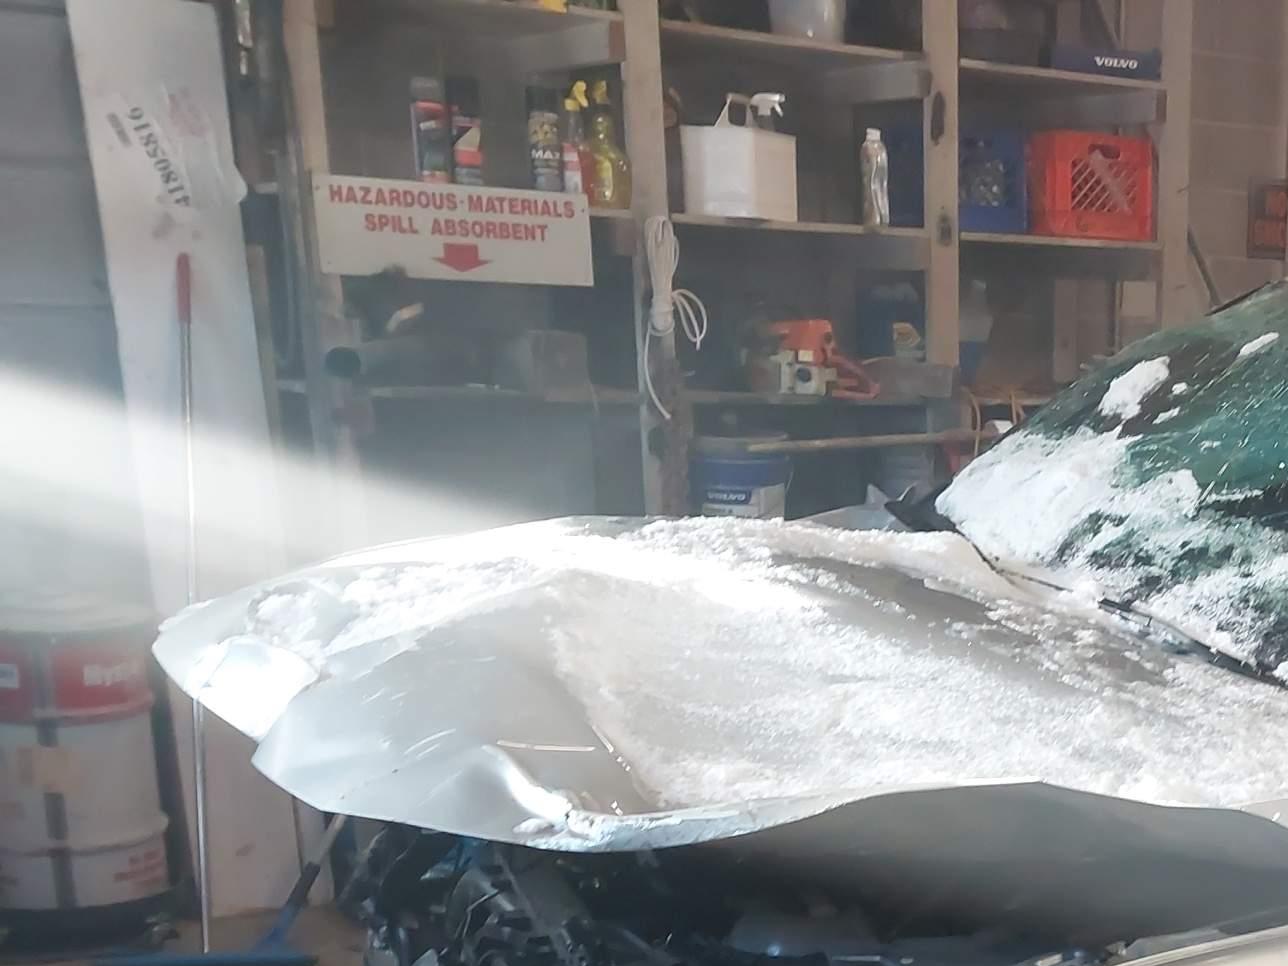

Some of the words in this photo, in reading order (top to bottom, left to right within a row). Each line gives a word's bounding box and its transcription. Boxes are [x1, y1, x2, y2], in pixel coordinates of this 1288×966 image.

[1094, 55, 1139, 70] VOLVO
[328, 183, 459, 212] HAZARDOUS
[467, 194, 576, 219] MATERIALS
[364, 212, 419, 235] SPILL
[430, 217, 549, 243] ABSORBENT
